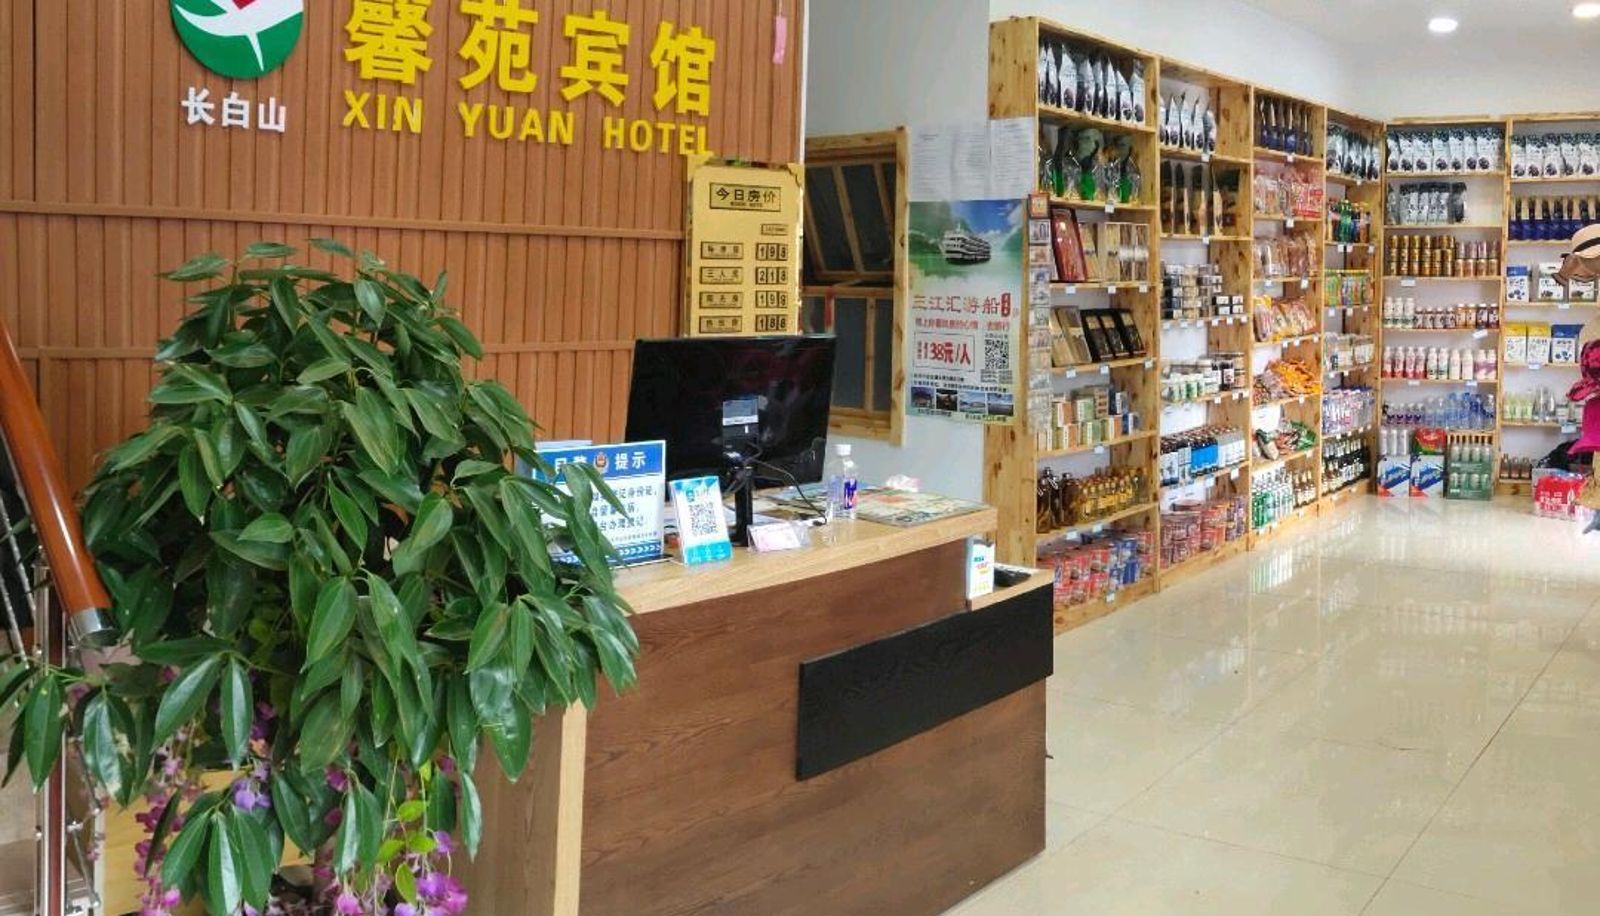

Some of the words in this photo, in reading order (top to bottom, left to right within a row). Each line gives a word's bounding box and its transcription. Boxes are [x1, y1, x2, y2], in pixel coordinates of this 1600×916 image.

[344, 0, 716, 116] 馨苑宾馆
[181, 86, 287, 132] 长白山
[342, 90, 423, 134] XIN
[458, 102, 574, 145] YUAN
[603, 116, 714, 157] HOTEL
[715, 186, 776, 203] 今日房价
[759, 245, 786, 259] 198
[759, 269, 786, 283] 218
[911, 295, 1000, 314] 三江汇游船
[759, 317, 786, 330] 188
[614, 451, 647, 470] 提示
